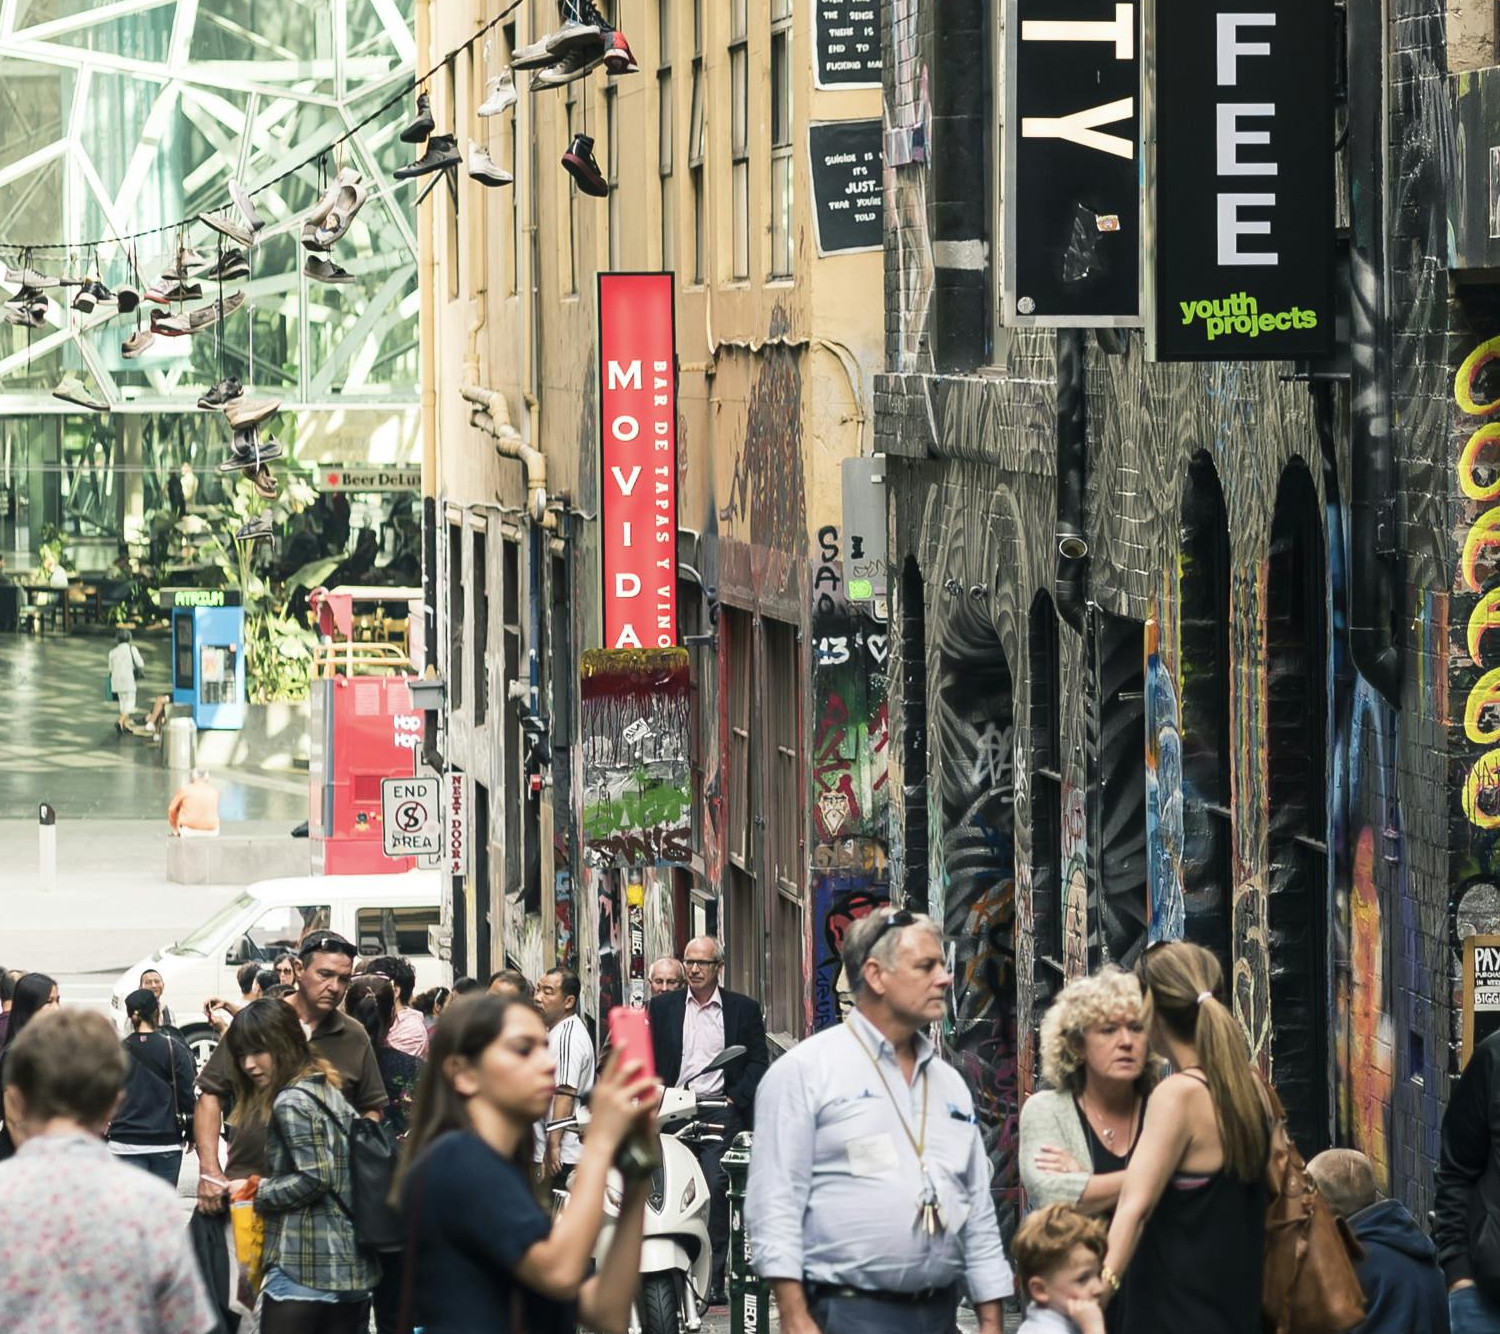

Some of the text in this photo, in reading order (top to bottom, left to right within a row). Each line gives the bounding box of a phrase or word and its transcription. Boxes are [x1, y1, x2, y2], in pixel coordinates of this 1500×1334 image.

[823, 11, 838, 20] THE
[864, 27, 874, 36] IS
[828, 44, 870, 54] END TO
[864, 152, 873, 161] IS
[1180, 292, 1257, 324] youth
[1207, 306, 1317, 340] projects
[653, 361, 668, 406] BAR
[654, 421, 669, 450] DE
[342, 473, 375, 485] Beer
[608, 360, 643, 649] MOVIDA
[655, 465, 670, 543] TAPAS
[656, 558, 670, 570] Y
[394, 785, 427, 798] END
[452, 776, 462, 858] NEXT DOOR
[392, 834, 432, 848] AREA
